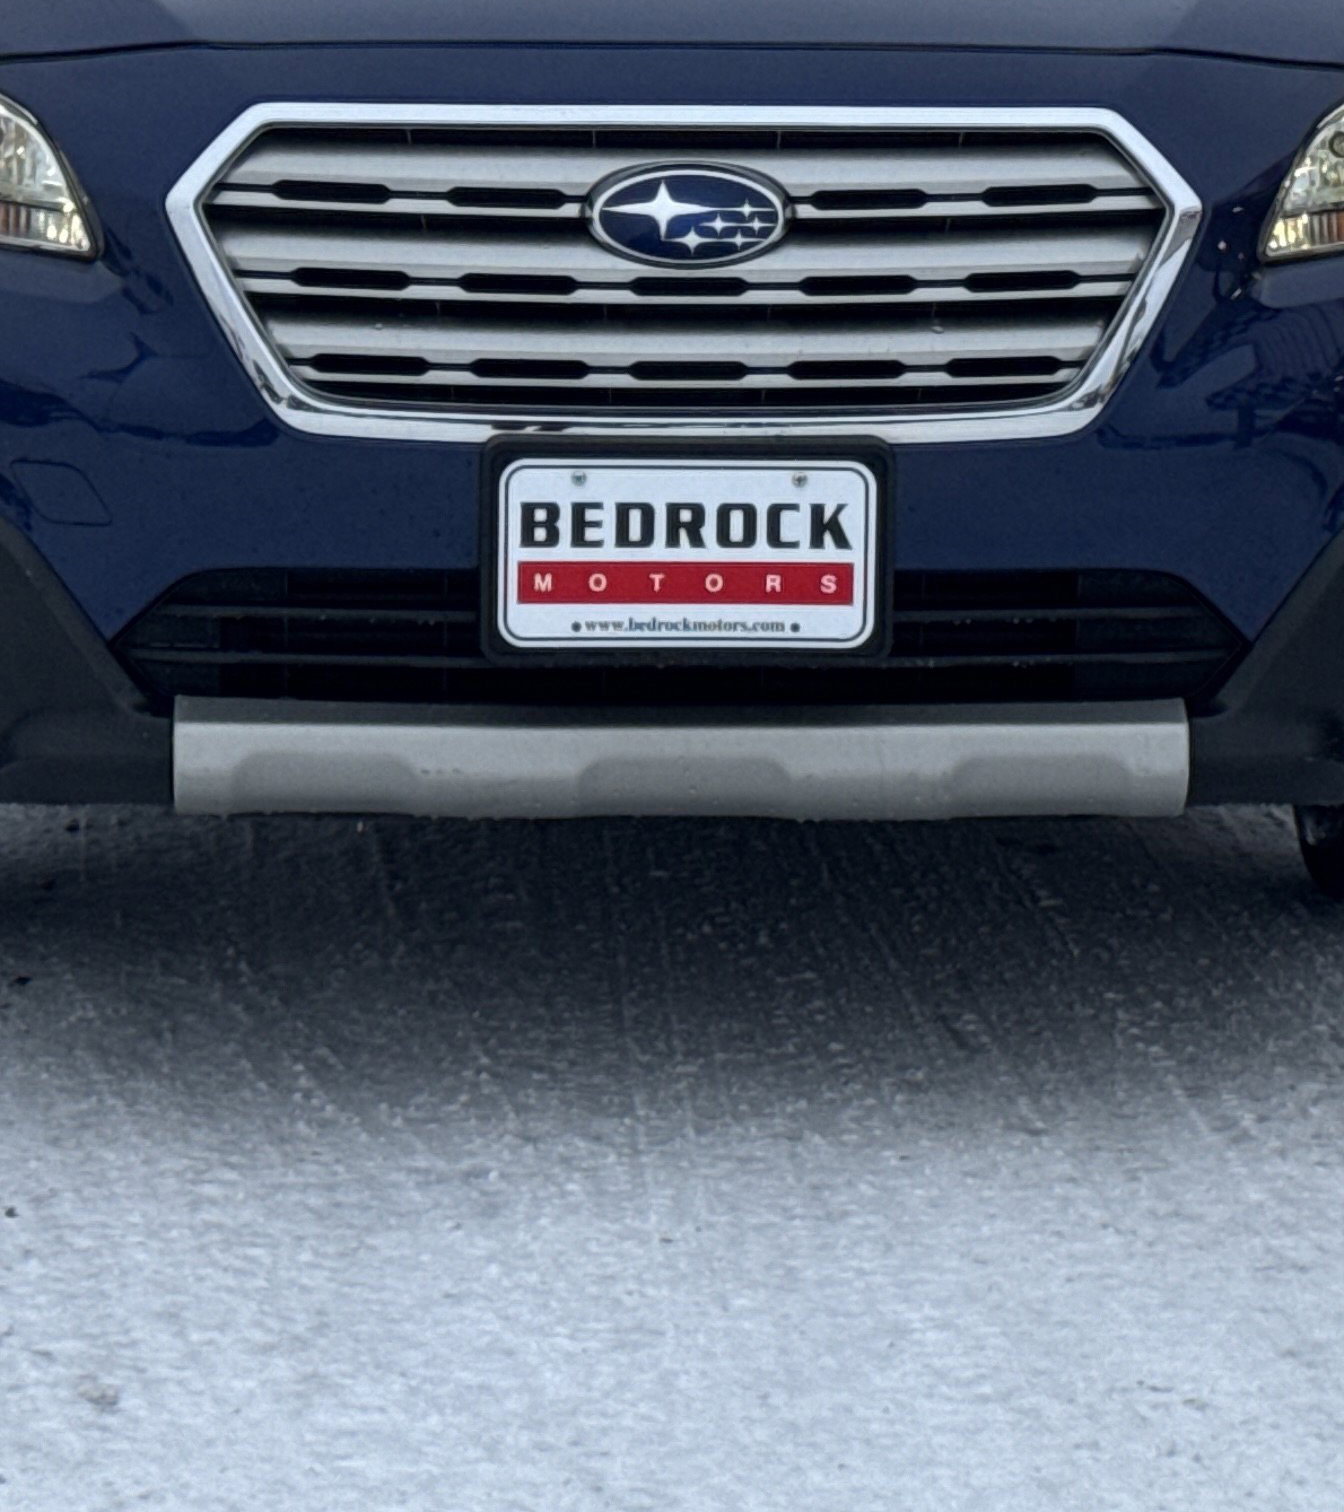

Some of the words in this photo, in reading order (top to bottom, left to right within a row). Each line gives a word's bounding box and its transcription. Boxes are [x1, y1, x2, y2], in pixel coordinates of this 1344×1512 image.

[519, 501, 853, 550] BEDROCK
[532, 573, 838, 593] MOTORS
[585, 617, 786, 633] www.bedrockmotors.com
